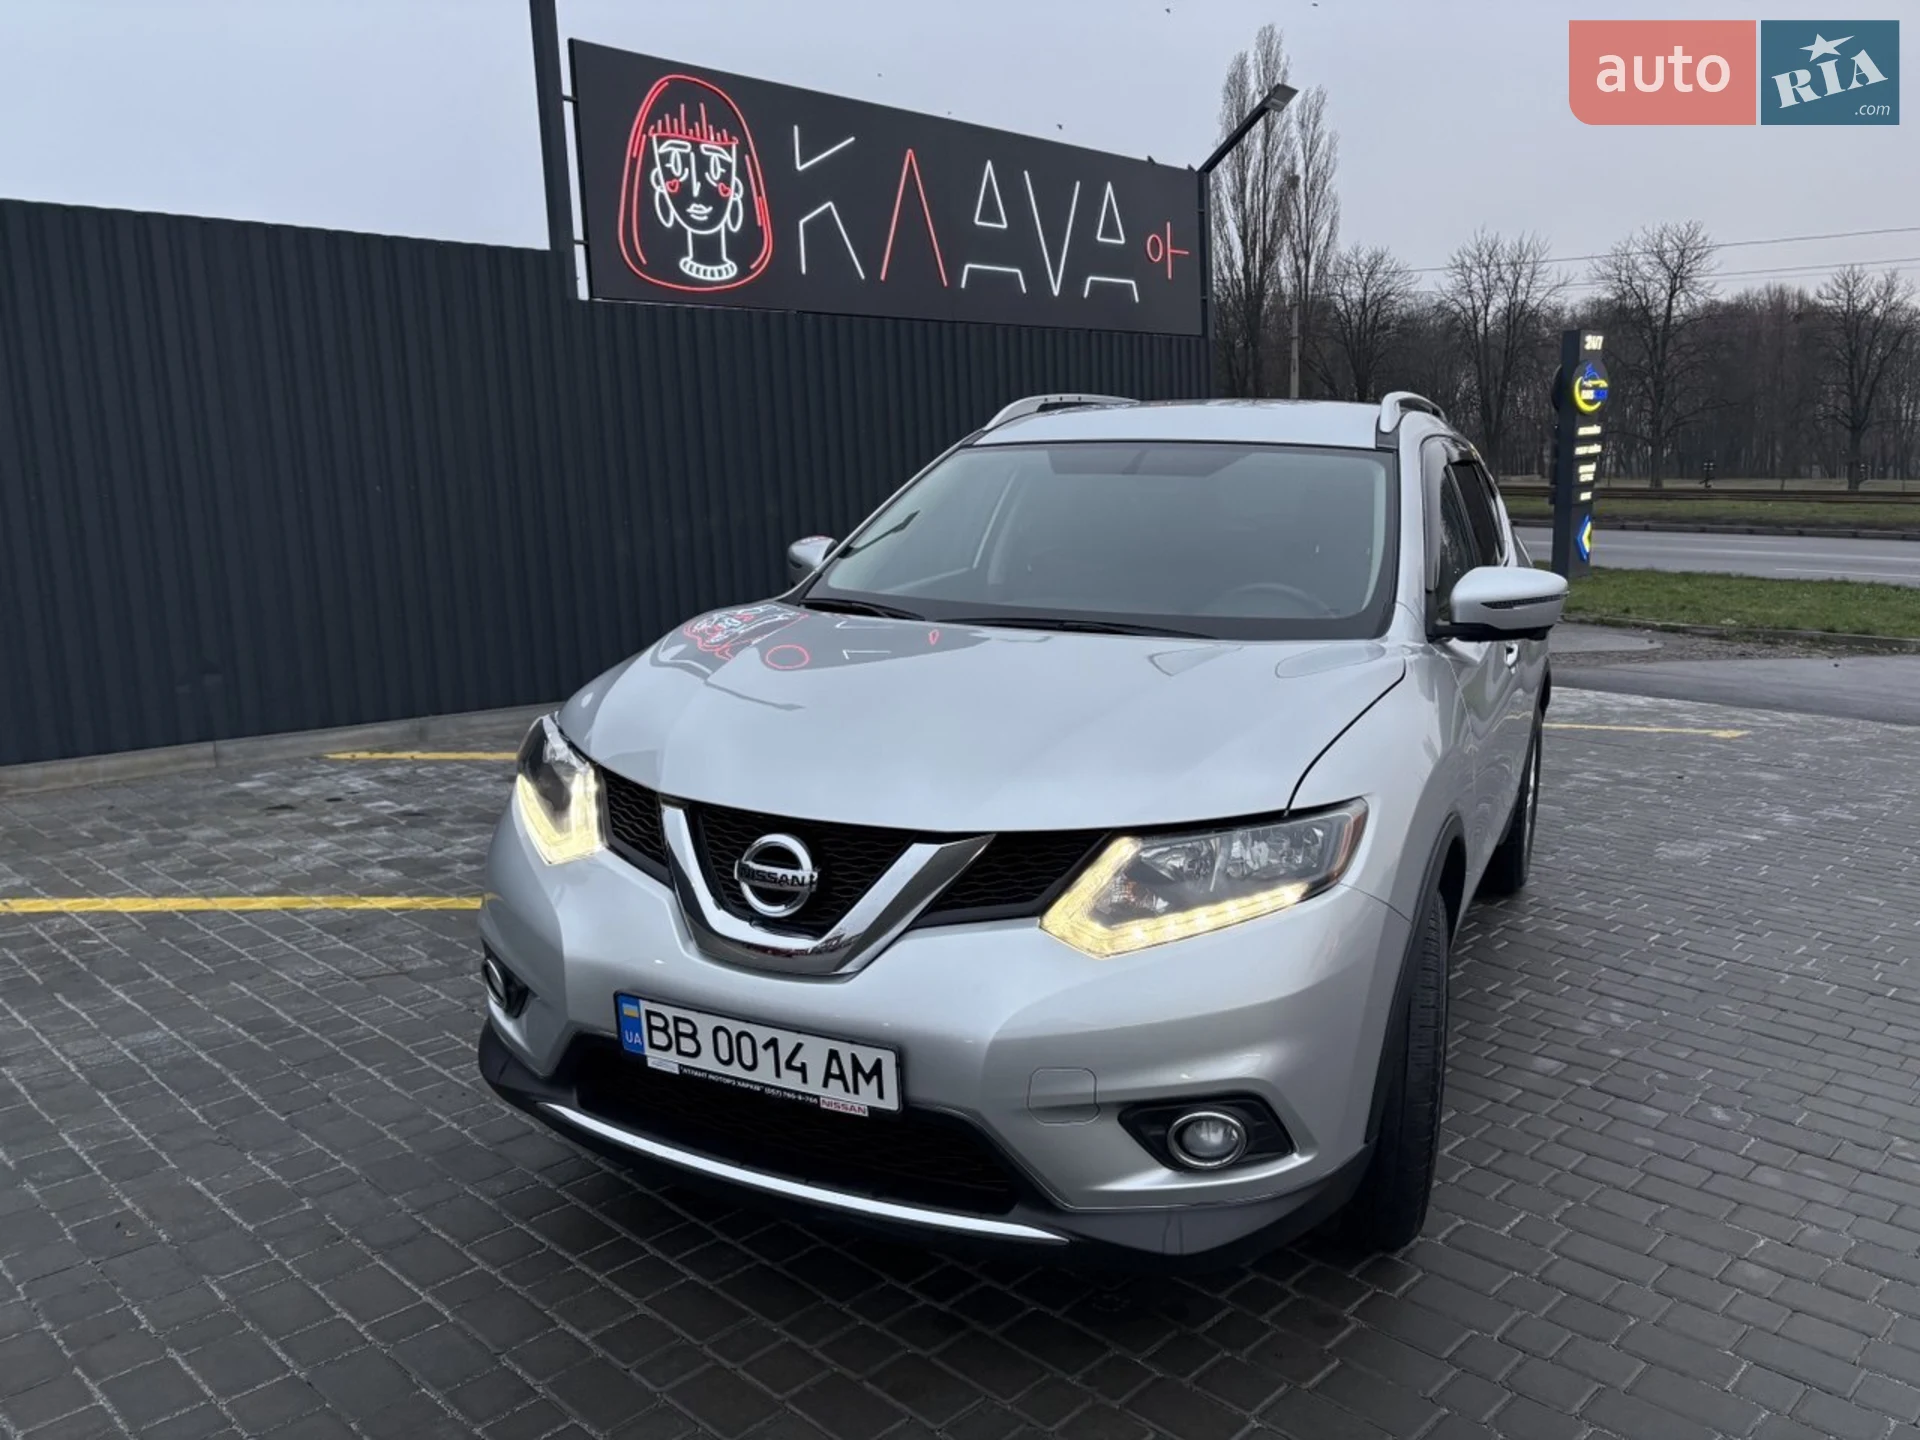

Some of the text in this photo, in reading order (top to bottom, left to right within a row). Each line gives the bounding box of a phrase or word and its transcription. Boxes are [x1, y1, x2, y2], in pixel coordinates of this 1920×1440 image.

[741, 868, 806, 887] NISSAN
[625, 1030, 642, 1045] UA
[645, 1009, 885, 1100] BB 0014 AM
[822, 1099, 866, 1115] NISSAN
